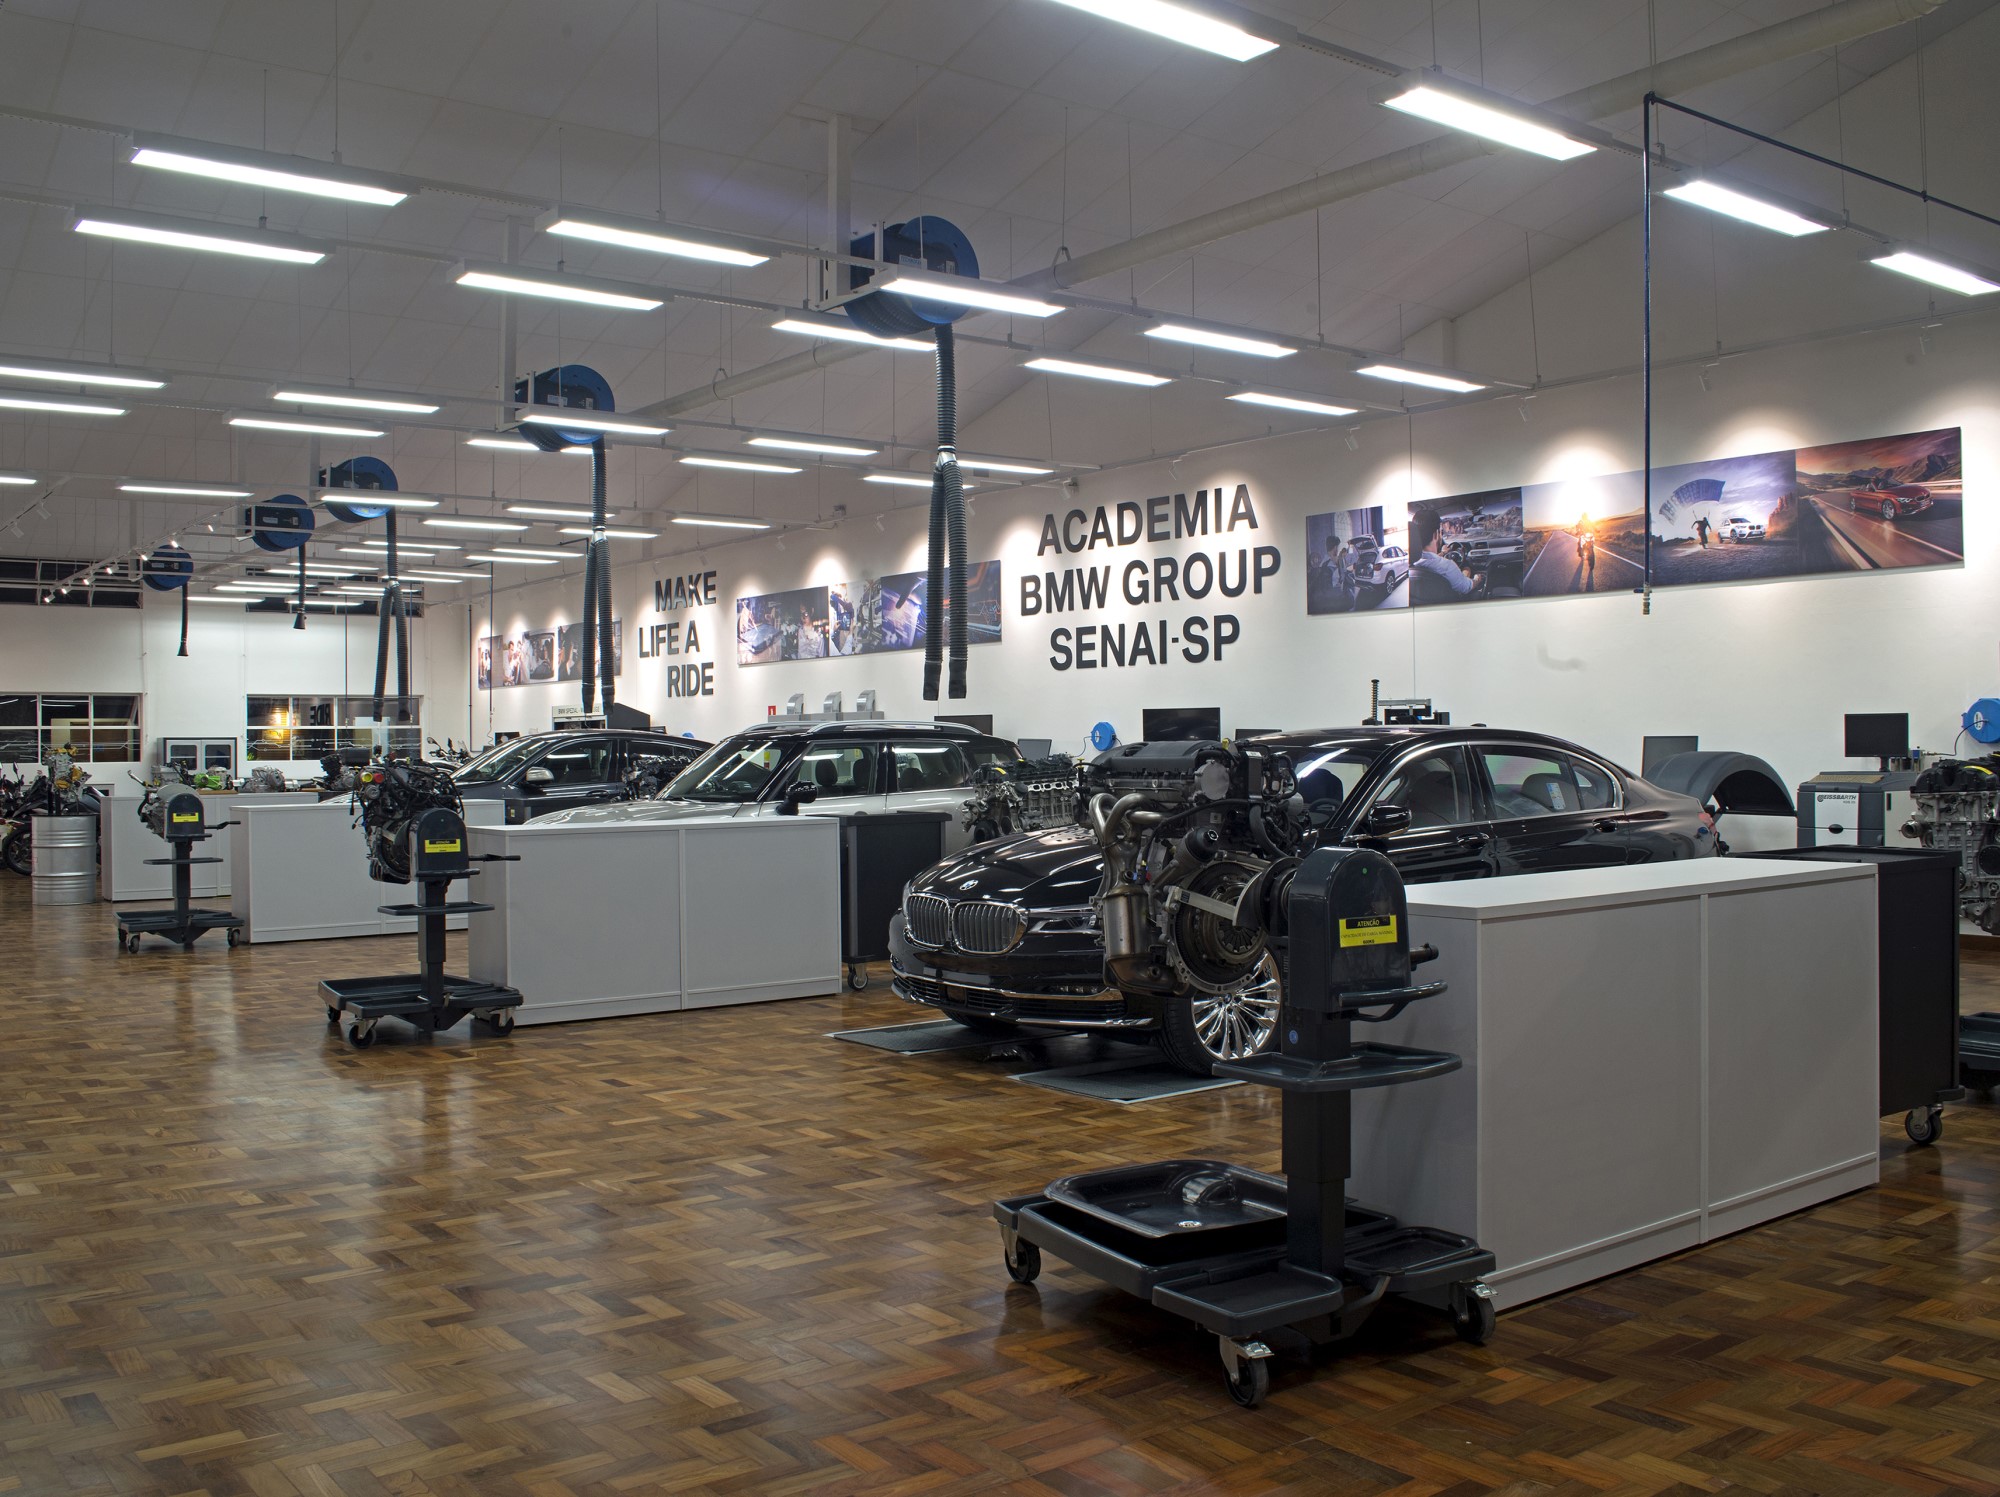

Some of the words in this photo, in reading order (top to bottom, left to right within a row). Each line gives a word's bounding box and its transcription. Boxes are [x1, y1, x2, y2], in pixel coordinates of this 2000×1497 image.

[1037, 484, 1258, 556] ACADEMIA
[655, 570, 717, 612] MAKE
[1021, 565, 1111, 616] BMW
[1122, 545, 1281, 605] GROUP
[639, 622, 679, 658] LIFE
[684, 620, 700, 654] A
[1050, 614, 1240, 671] SENAI-SP
[667, 662, 714, 698] RIDE
